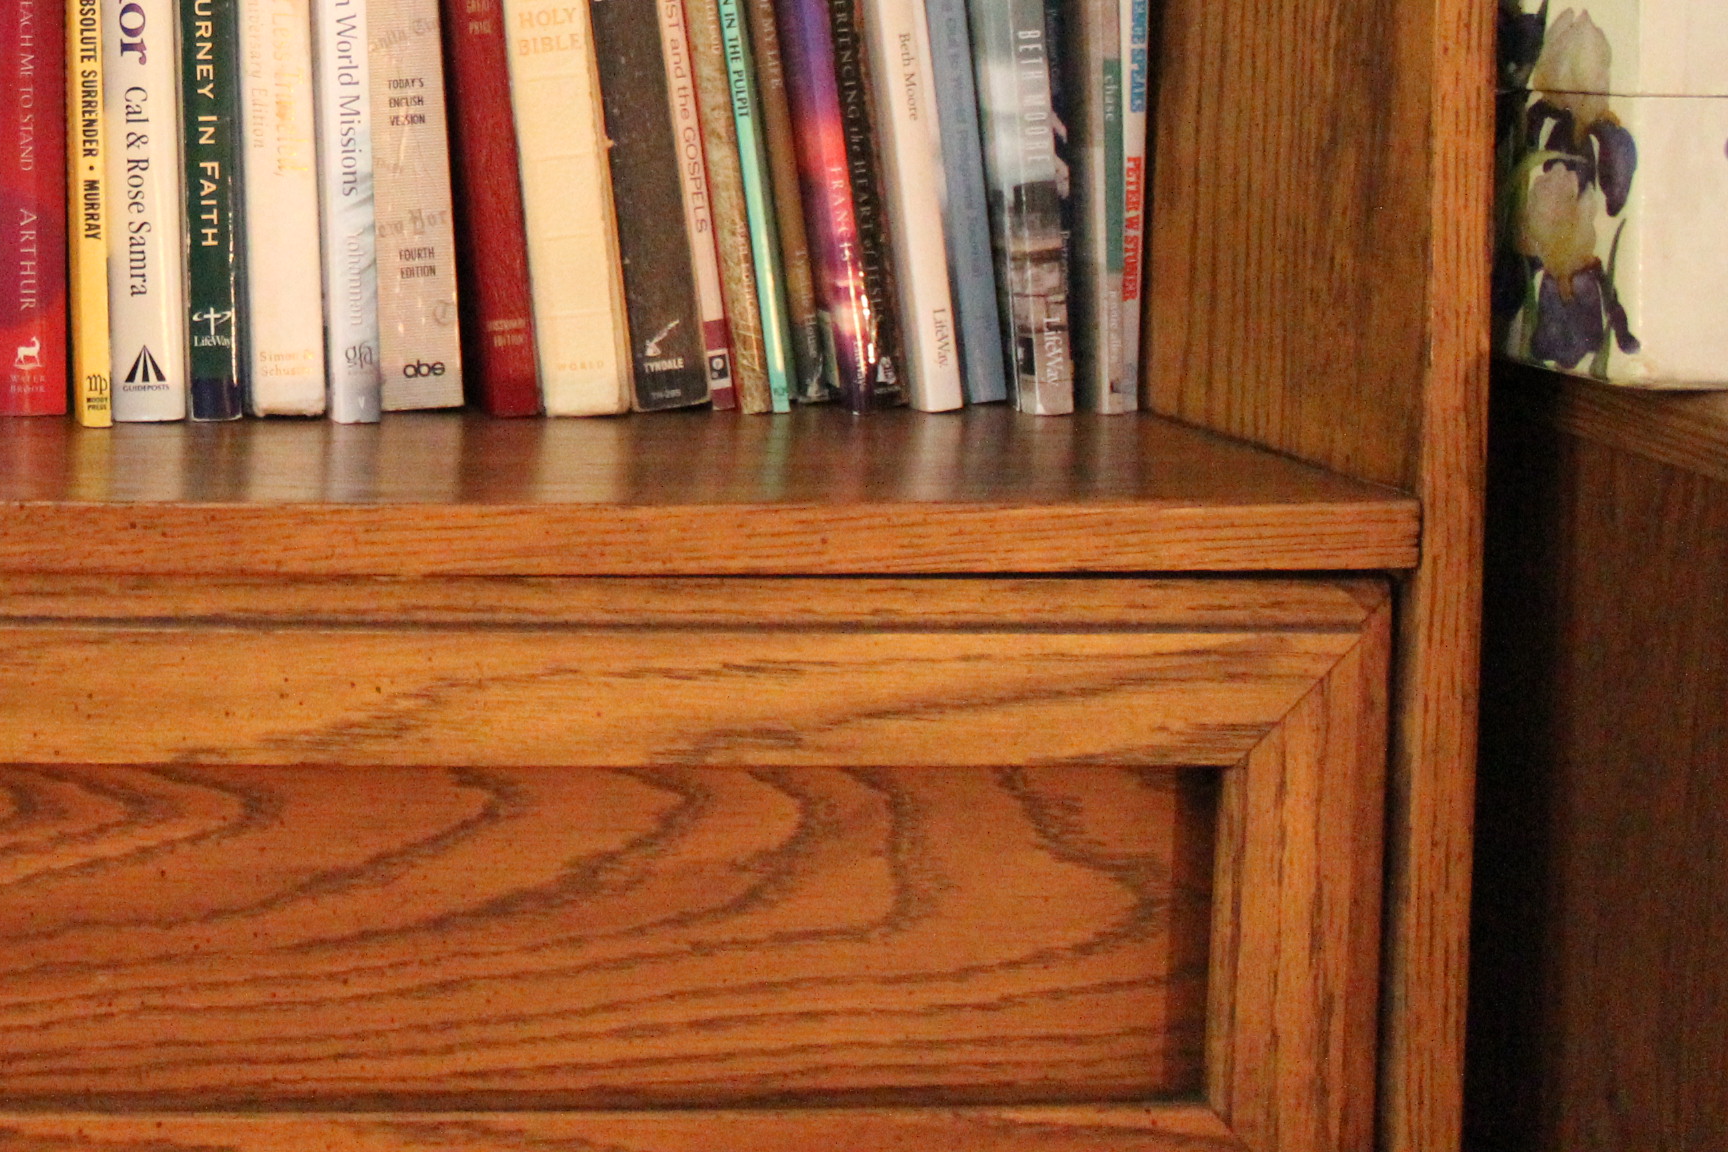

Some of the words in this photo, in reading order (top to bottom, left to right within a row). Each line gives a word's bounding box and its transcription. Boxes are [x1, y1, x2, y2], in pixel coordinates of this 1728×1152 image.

[518, 8, 577, 28] HOLY
[723, 12, 736, 29] IN
[762, 17, 777, 43] MY
[335, 14, 359, 86] World
[518, 33, 582, 56] BIBLE
[669, 37, 687, 79] and
[728, 34, 744, 63] THE
[899, 32, 912, 69] Beth
[1017, 29, 1045, 80] BETH
[767, 49, 783, 89] LIFE
[80, 70, 99, 158] SURRENDER
[124, 85, 150, 123] Cal
[389, 96, 424, 108] ENGLISH
[673, 84, 690, 120] the
[731, 69, 750, 119] PULPIT
[902, 73, 918, 121] Moore
[1104, 75, 1118, 121] chase
[126, 131, 149, 149] &
[197, 115, 218, 145] IN
[251, 88, 269, 149] Edition
[849, 127, 863, 152] the
[1024, 94, 1051, 163] MOORE
[337, 94, 361, 198] Missions
[126, 158, 150, 215] Rose
[683, 127, 708, 233] GOSPELS
[854, 160, 874, 231] HEART
[1124, 156, 1142, 214] PETER
[83, 179, 102, 241] MURRAY
[199, 161, 220, 247] FAITH
[19, 208, 37, 311] ARTHUR
[129, 221, 152, 297] Samra
[399, 247, 435, 261] FOURTH
[400, 265, 436, 279] EDITION
[1122, 235, 1140, 302] STONER
[193, 335, 232, 349] LifeWay
[1042, 315, 1063, 387] LifeWay
[643, 358, 684, 373] TYNDALE
[122, 384, 170, 392] GUIDEPOSTS
